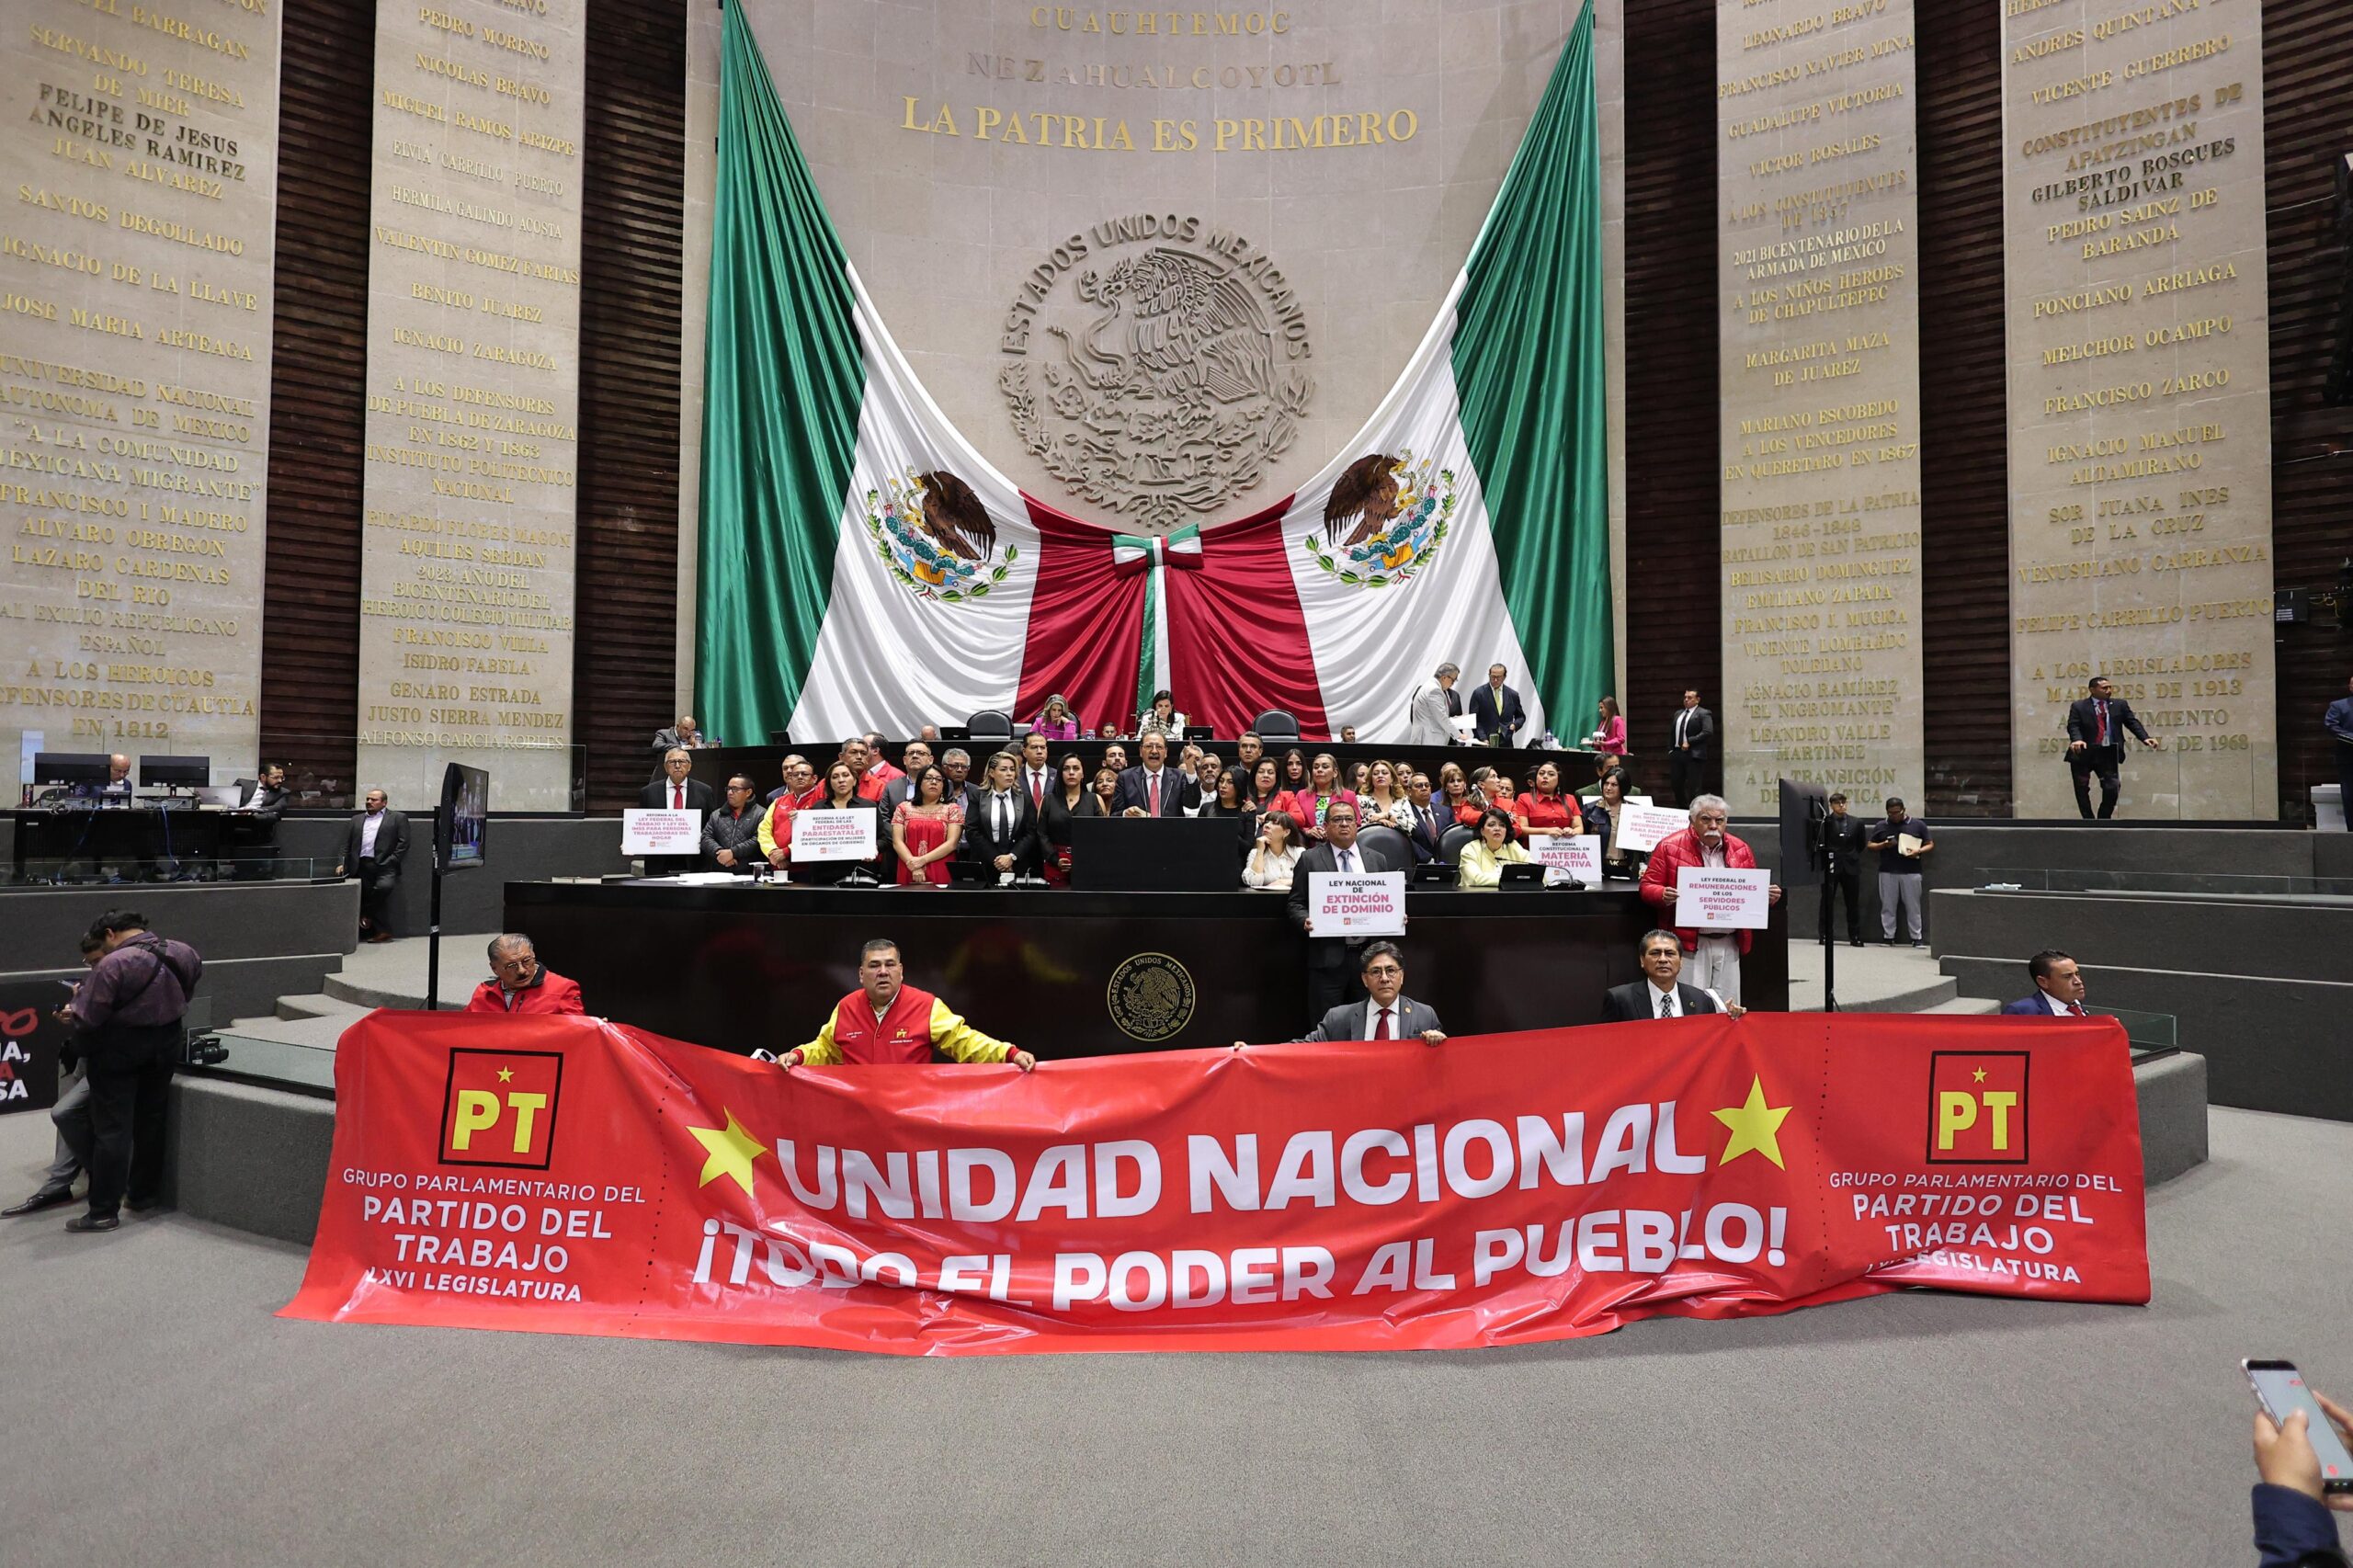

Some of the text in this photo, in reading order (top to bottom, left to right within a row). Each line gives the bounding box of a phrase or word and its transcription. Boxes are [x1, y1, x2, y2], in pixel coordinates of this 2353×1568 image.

[419, 7, 549, 60] PEDRO MORENO
[1030, 6, 1291, 36] CUAUHTEMOC
[1744, 0, 1885, 51] LEONARDO BRAVO
[415, 53, 550, 105] NICOLAS BRAVO
[967, 51, 1342, 89] NEZAHUALCOYOTL
[2031, 33, 2234, 104] VICENTE GUERRERO
[40, 83, 238, 156] FELIPE DE JESUS
[382, 91, 575, 156] MIGUEL RAMOS ARIZPE
[901, 96, 1419, 153] LA PATRIA ES PRIMERO
[1729, 83, 1903, 138] GUADALUPE VICTORIA
[29, 106, 246, 182] ANGELES RAMIREZ
[1749, 134, 1881, 178] VICTOR ROSALES
[52, 138, 223, 199] JUAN ALVAREZ
[393, 140, 563, 196] ELVIA CARRILLO PUERTO
[2032, 138, 2235, 203] GILBERTO BOSQUES
[392, 185, 563, 239] HERMILA GALINDO ACOSTA
[2079, 172, 2184, 211] SALDIVAR
[18, 185, 244, 256] SANTOS DEGOLLADO
[2048, 187, 2218, 242] PEDRO SAINZ DE
[375, 226, 580, 285] VALENTIN GOMEZ FARIAS
[1733, 218, 1904, 267] 2021 BICENTENARIO DE LA
[1747, 240, 1885, 280] ARMADA DE MEXICO
[2083, 222, 2180, 259] BARANDA
[2, 236, 257, 312] IGNACIO DE LA LLAVE
[1001, 213, 1313, 360] ESTADOS UNIDOS MEXICANOS
[2034, 262, 2236, 318] PONCIANO ARRIAGA
[412, 283, 542, 323] BENITO JUAREZ
[1, 294, 253, 361] JOSE MARIA ARTEAGA
[393, 327, 557, 371] IGNACIO ZARAGOZA
[2043, 315, 2234, 366] MELCHOR OCAMPO
[1746, 332, 1890, 368] MARGARITA MAZA
[1774, 358, 1860, 386] DE JUAREZ
[2044, 369, 2230, 415] FRANCISCO ZARCO
[1741, 399, 1898, 435] MARIANO ESCOBEDO
[2048, 424, 2225, 463] IGNACIO MANUEL
[2070, 453, 2201, 484] ALTAMIRANO
[21, 517, 225, 557] ALVARO OBREGON
[12, 545, 229, 585] LAZARO CARDENAS
[1732, 558, 1911, 586] BELISARIO DOMINGUEZ
[1746, 585, 1892, 608] EMILIANO ZAPATA
[390, 682, 541, 705] GENARO ESTRADA
[369, 706, 563, 729] JUSTO SIERRA MENDEZ
[1541, 852, 1588, 860] MATERIA
[1323, 904, 1393, 914] DE DOMINIO
[1326, 892, 1389, 903] EXTINCIÓN
[1111, 957, 1191, 997] ESTADOS UNIDOS MEXICANOS
[451, 1090, 547, 1153] PT
[1938, 1091, 2018, 1151] PT
[777, 1099, 1708, 1226] UNIDAD NACIONAL
[1829, 1172, 2122, 1193] GRUPO PARLAMENTARIO DEL
[343, 1167, 646, 1204] GRUPO PARLAMENTARIO DEL
[363, 1197, 612, 1240] PARTIDO DEL
[1853, 1194, 2094, 1225] PARTIDO DEL
[392, 1233, 570, 1274] TRABAJO
[1052, 1246, 1336, 1313] PODER
[1353, 1238, 1458, 1295] AL
[1475, 1201, 1787, 1289] PUEBLO!
[1885, 1222, 2054, 1255] TRABAJO
[424, 1272, 582, 1303] LEGISLATURA
